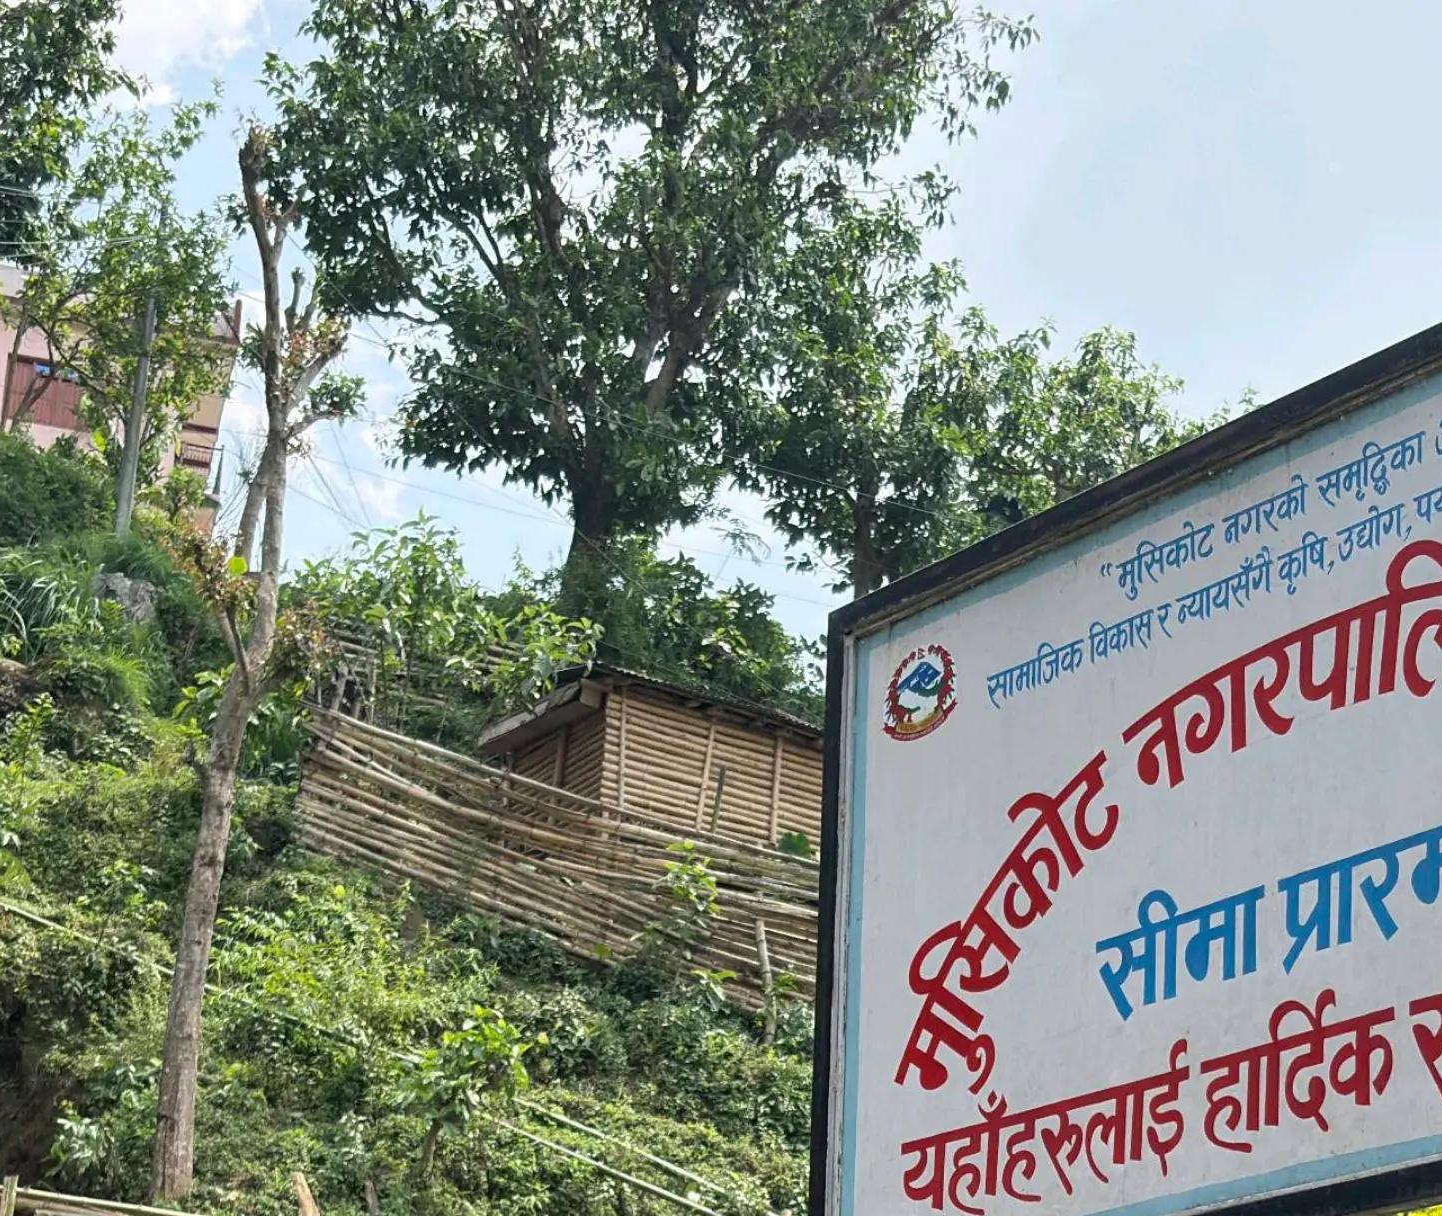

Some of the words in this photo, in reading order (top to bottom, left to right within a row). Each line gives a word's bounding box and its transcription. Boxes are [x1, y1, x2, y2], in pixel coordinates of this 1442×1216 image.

[1222, 474, 1309, 544] नगरको
[987, 642, 1084, 709] सामाजिक
[1089, 620, 1153, 664] विकास
[1157, 602, 1173, 639] र
[1278, 531, 1335, 596] कृषि,
[893, 750, 1121, 1095] मुसिकोट
[1094, 884, 1266, 1020] सीमा
[1199, 990, 1396, 1153] हार्दिक
